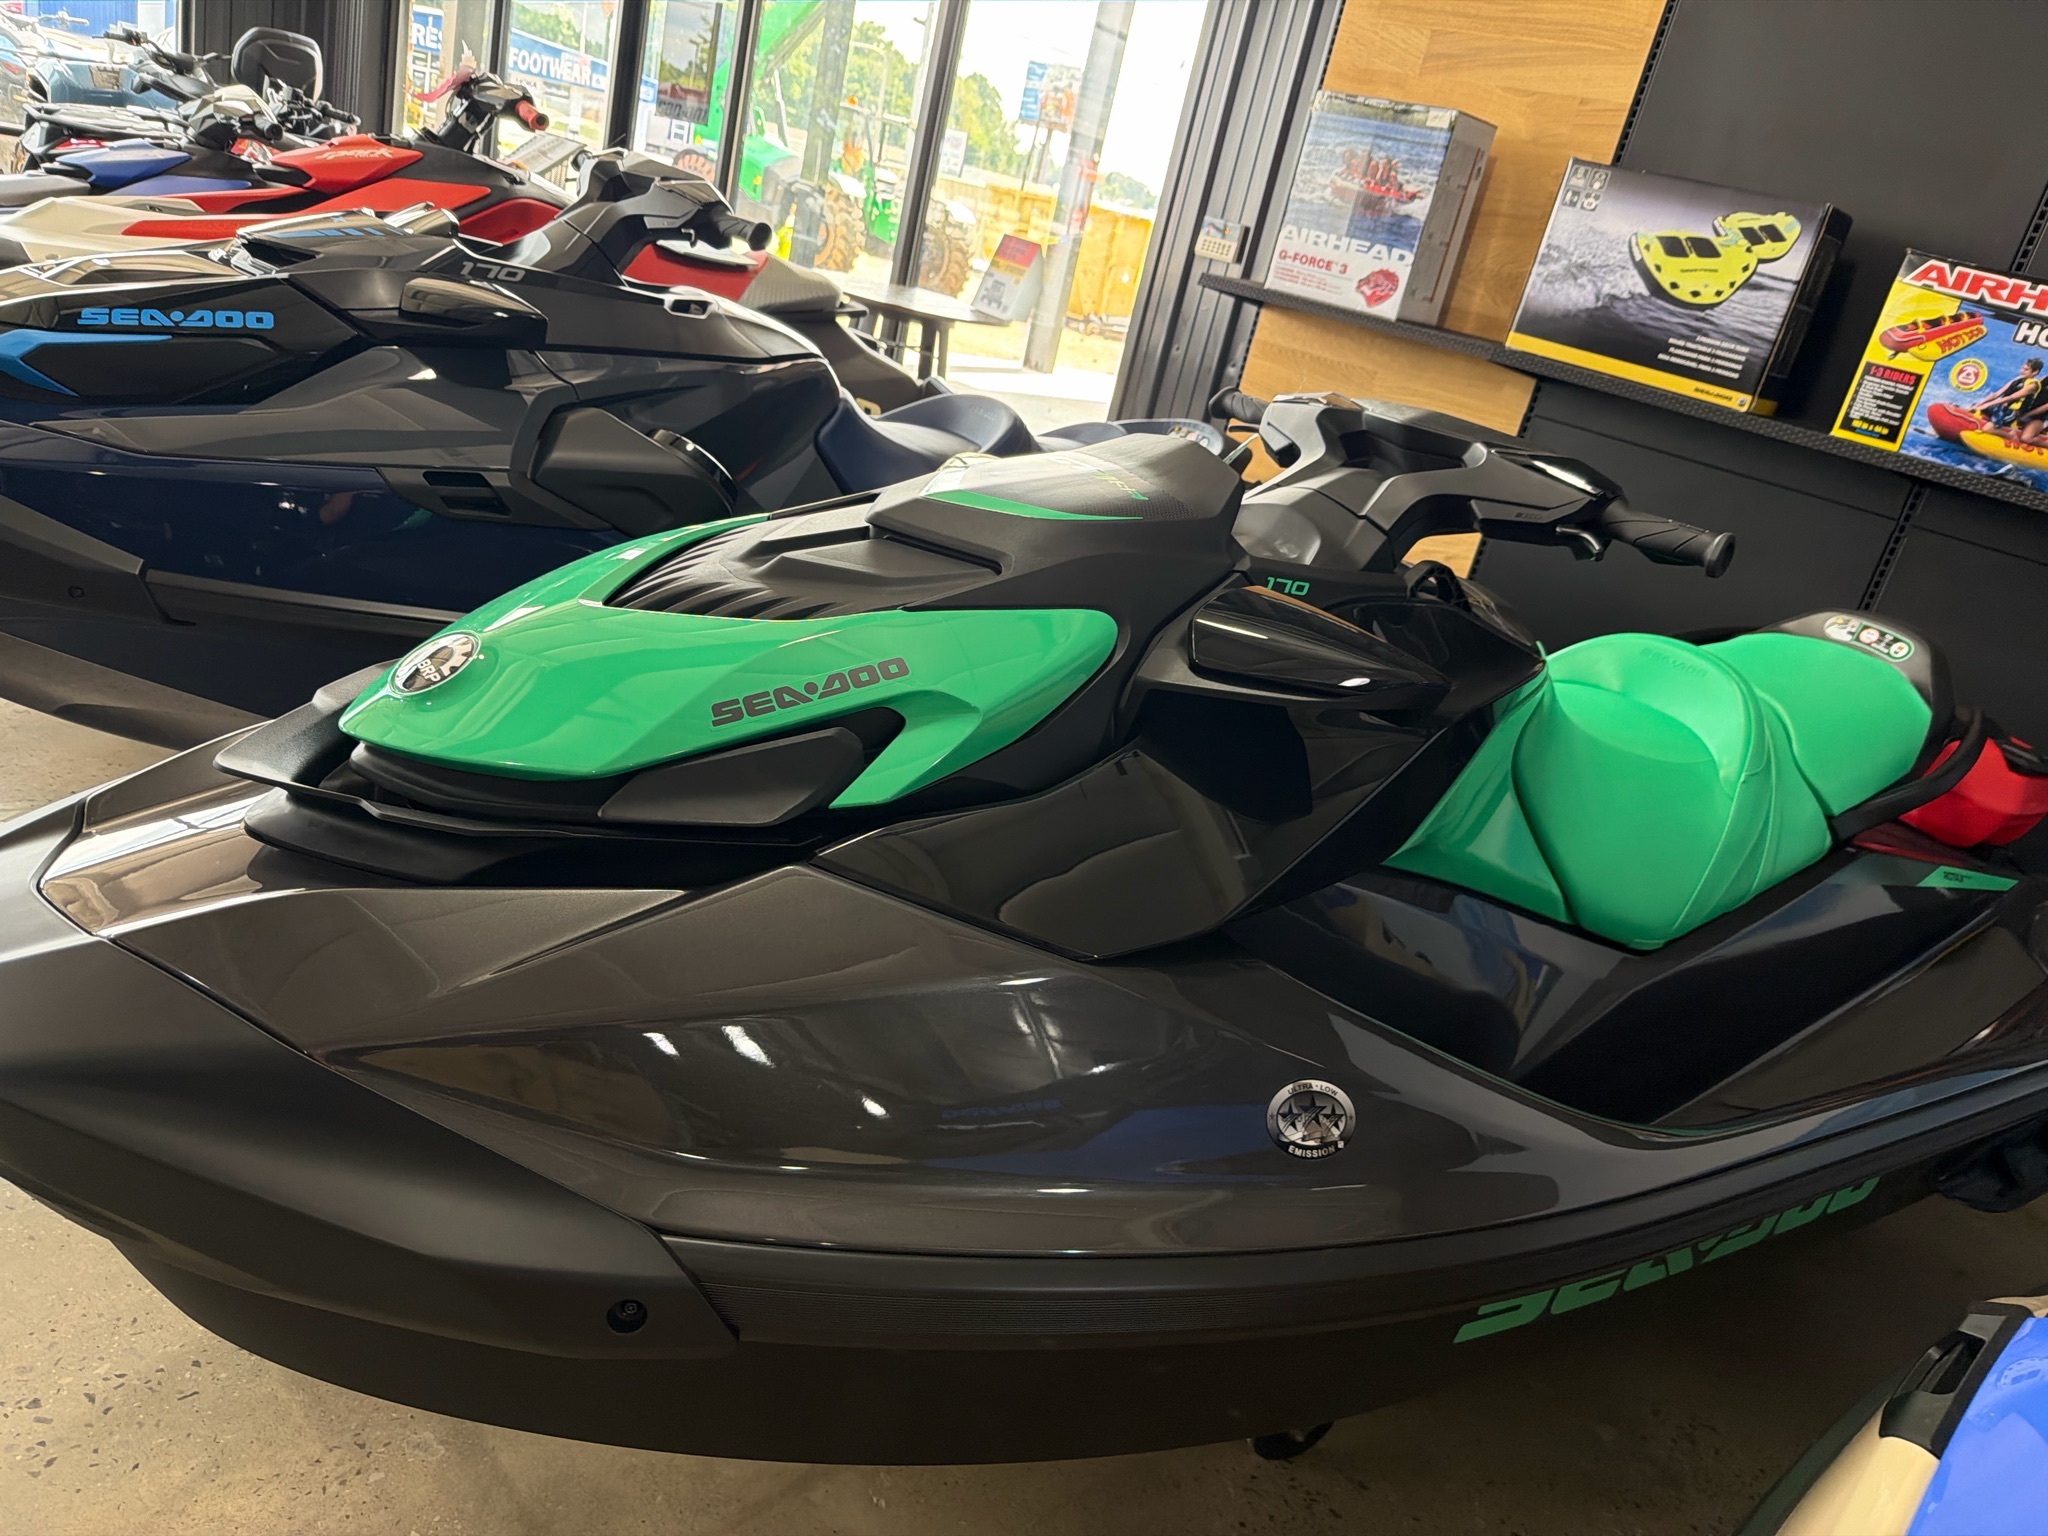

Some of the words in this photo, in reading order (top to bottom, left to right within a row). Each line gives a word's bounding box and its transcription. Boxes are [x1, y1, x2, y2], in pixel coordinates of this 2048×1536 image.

[508, 47, 592, 86] FOOTWEAR
[1281, 224, 1415, 267] AIRHEAD
[460, 261, 526, 282] 170
[1338, 263, 1349, 275] 3
[1884, 369, 1917, 385] RIDERS
[1267, 577, 1310, 596] 170
[417, 658, 442, 682] BRP
[1287, 1082, 1314, 1095] ULTRA
[1320, 1084, 1339, 1097] LOW
[1287, 1144, 1336, 1158] EMISSION
